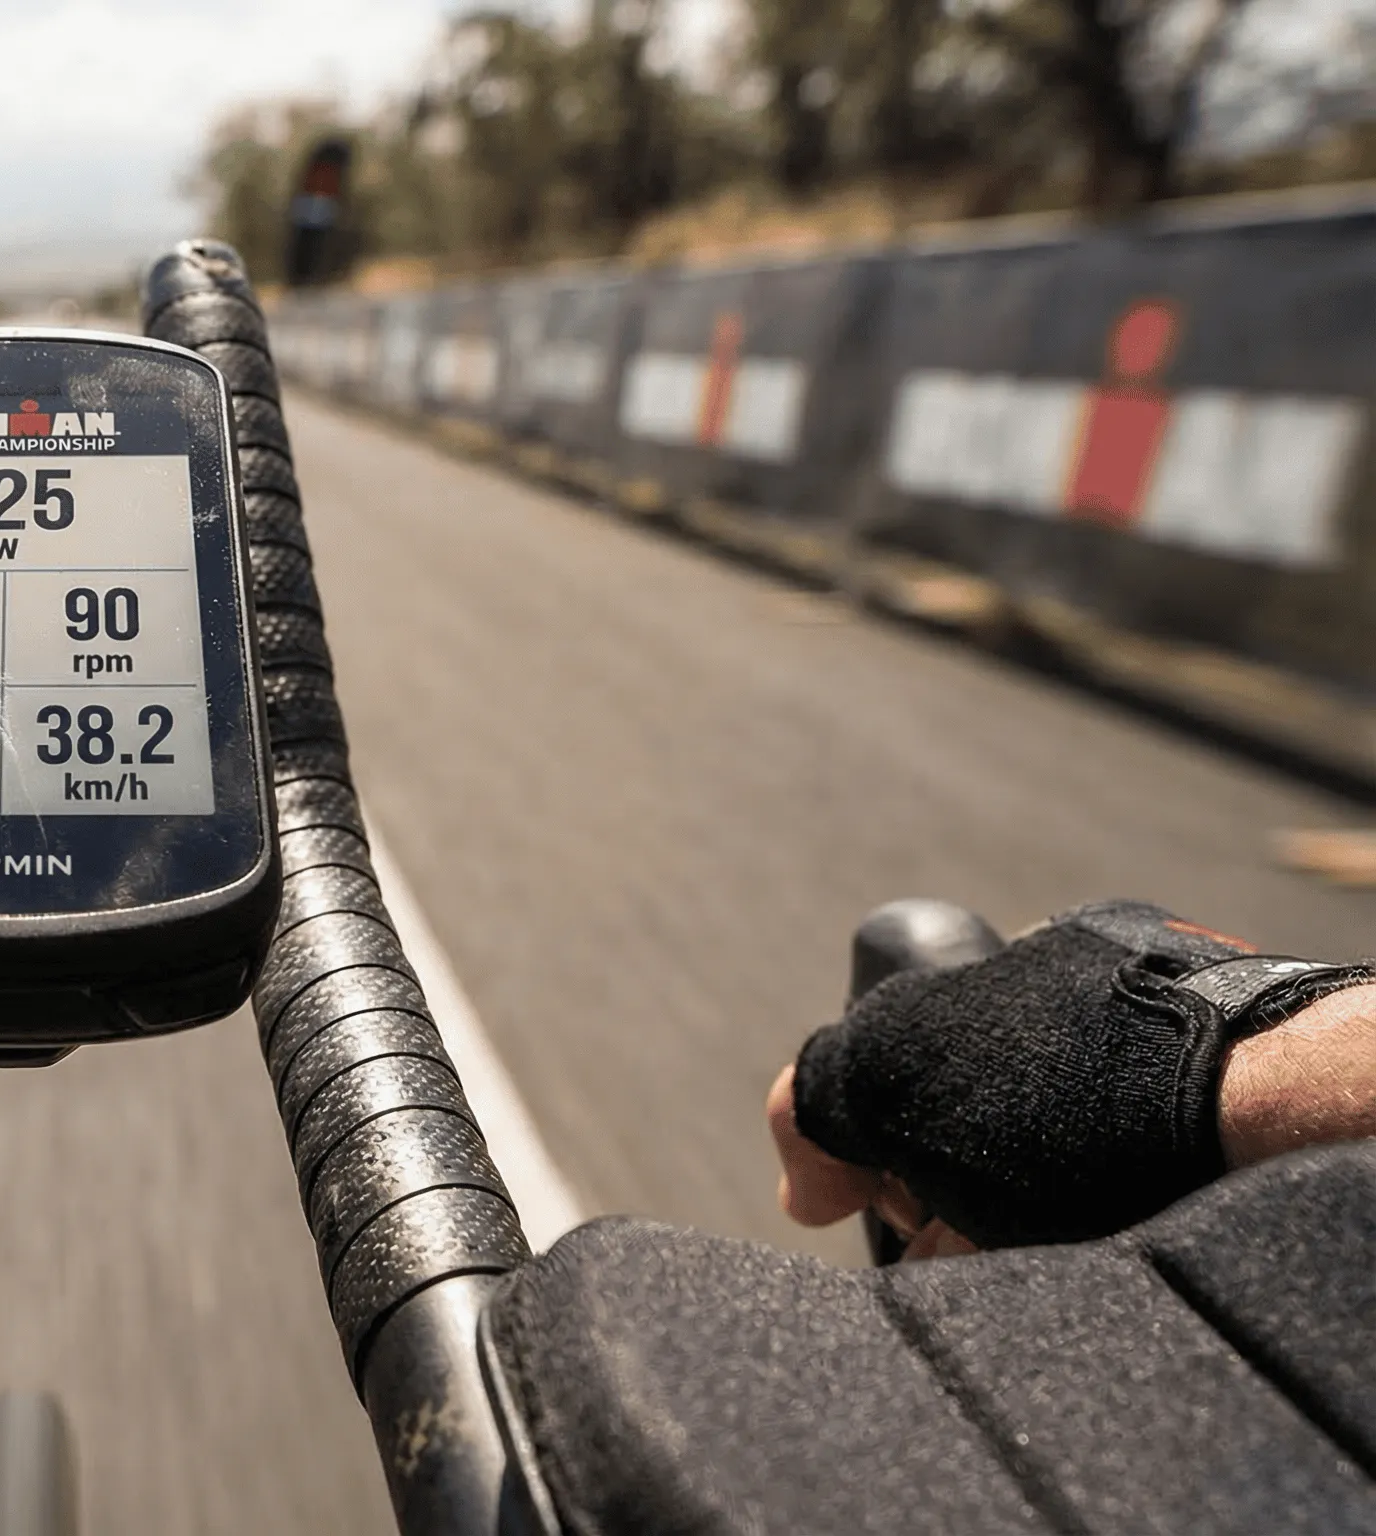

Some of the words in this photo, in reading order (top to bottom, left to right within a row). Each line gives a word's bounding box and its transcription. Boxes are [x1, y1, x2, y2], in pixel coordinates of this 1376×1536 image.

[65, 588, 140, 642] 90
[72, 653, 133, 679] rpm
[36, 705, 174, 765] 38.2
[64, 773, 148, 803] km/h
